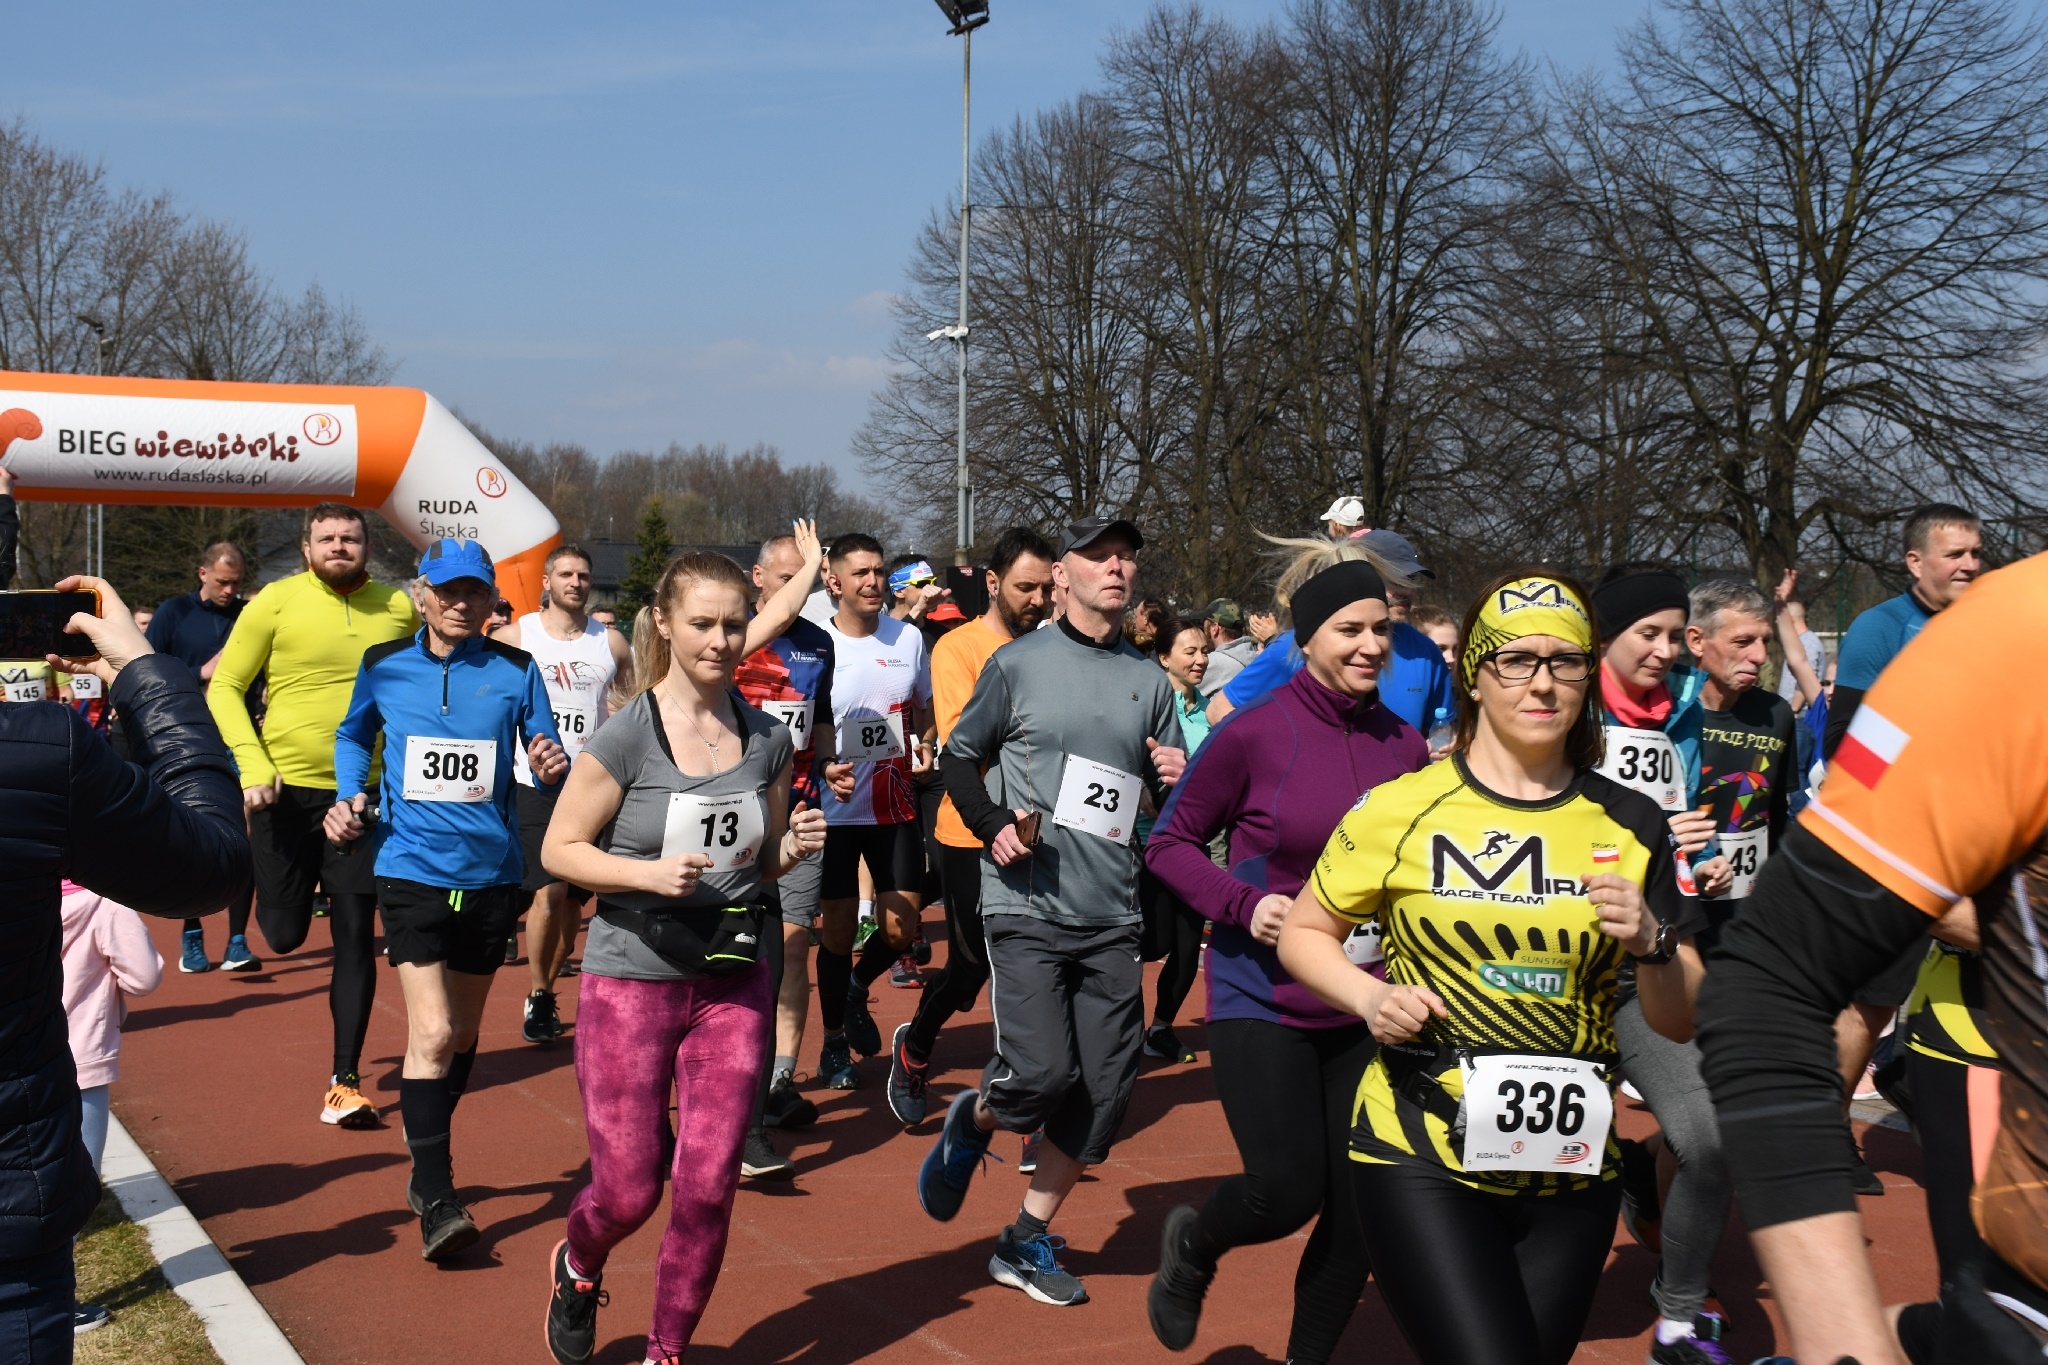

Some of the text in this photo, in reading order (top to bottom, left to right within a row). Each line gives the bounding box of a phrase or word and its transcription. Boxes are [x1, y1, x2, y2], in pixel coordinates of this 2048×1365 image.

[58, 429, 126, 456] BIEG
[94, 468, 268, 486] www.rudaslaska.pl
[418, 500, 478, 515] RUDA
[420, 518, 478, 539] Śląska
[14, 686, 40, 701] 145
[76, 679, 91, 690] 55
[781, 711, 806, 733] 74
[861, 725, 888, 748] 82
[422, 751, 479, 782] 308
[1618, 745, 1673, 785] 330
[1083, 782, 1120, 813] 23
[700, 811, 739, 848] 13
[1431, 888, 1544, 905] RACE TEAM
[1520, 955, 1571, 966] SUNSTAR
[1496, 1079, 1586, 1136] 336
